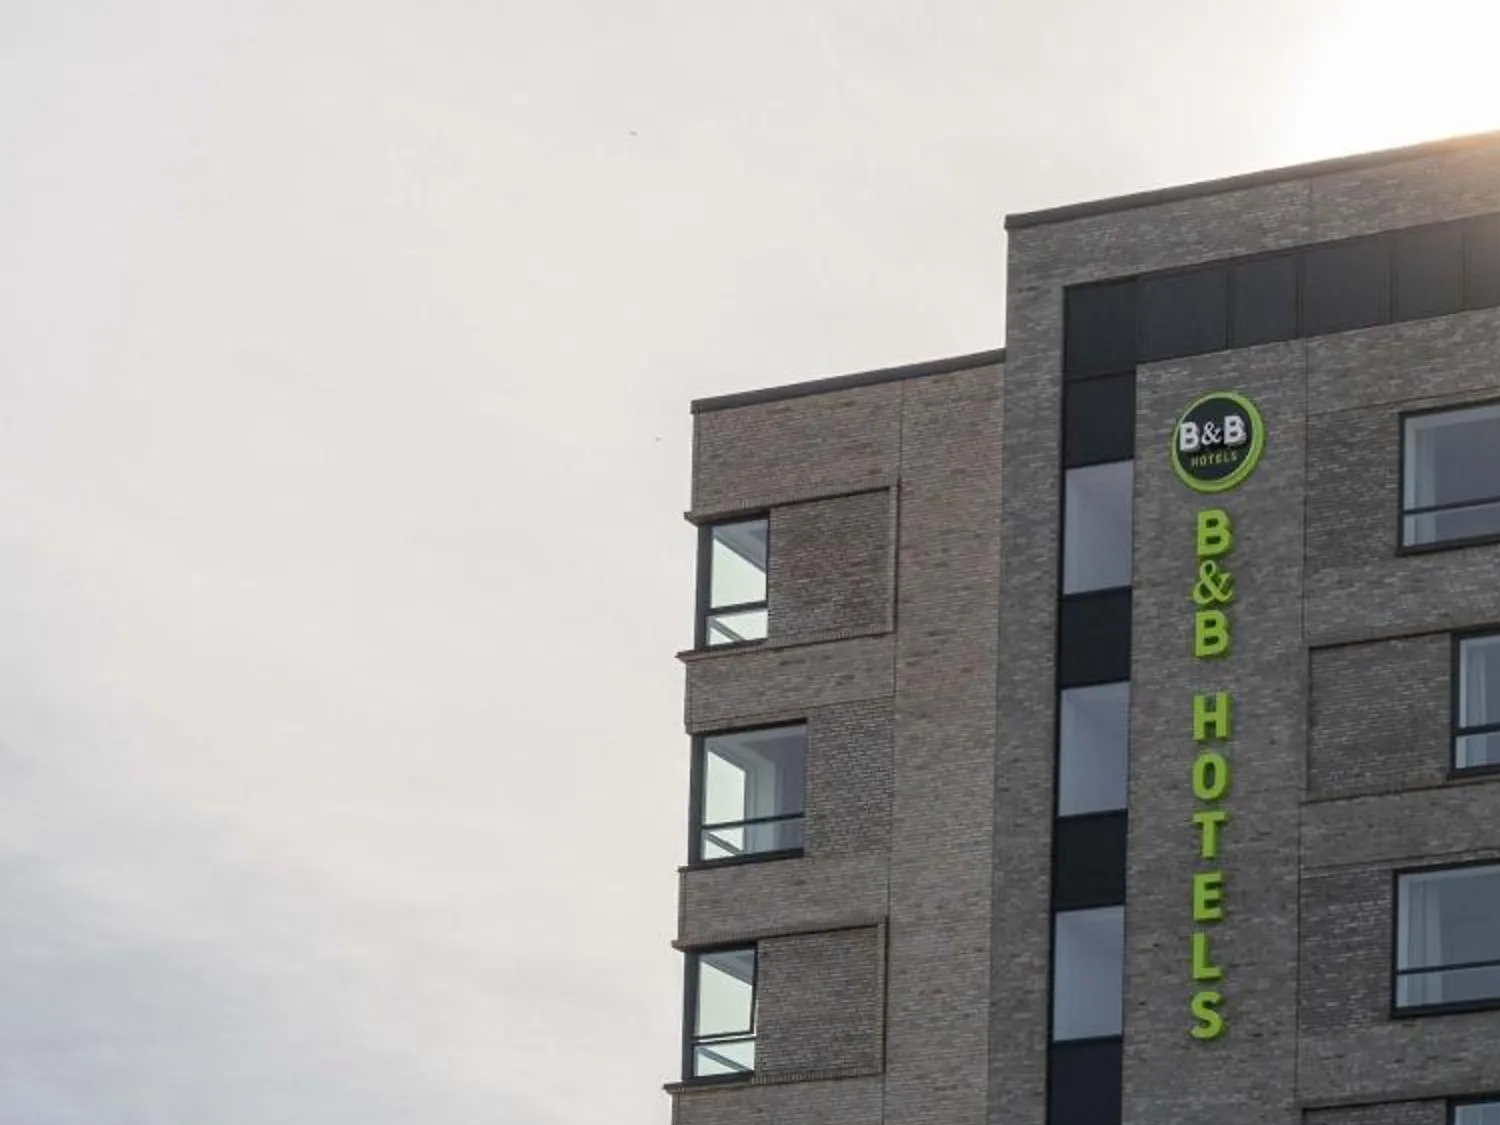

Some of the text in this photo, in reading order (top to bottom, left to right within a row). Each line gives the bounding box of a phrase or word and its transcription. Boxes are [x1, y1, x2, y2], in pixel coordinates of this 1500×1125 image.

[1179, 415, 1247, 451] B&B
[1191, 451, 1237, 468] HOTELS
[1191, 508, 1233, 1038] B&B HOTELS
